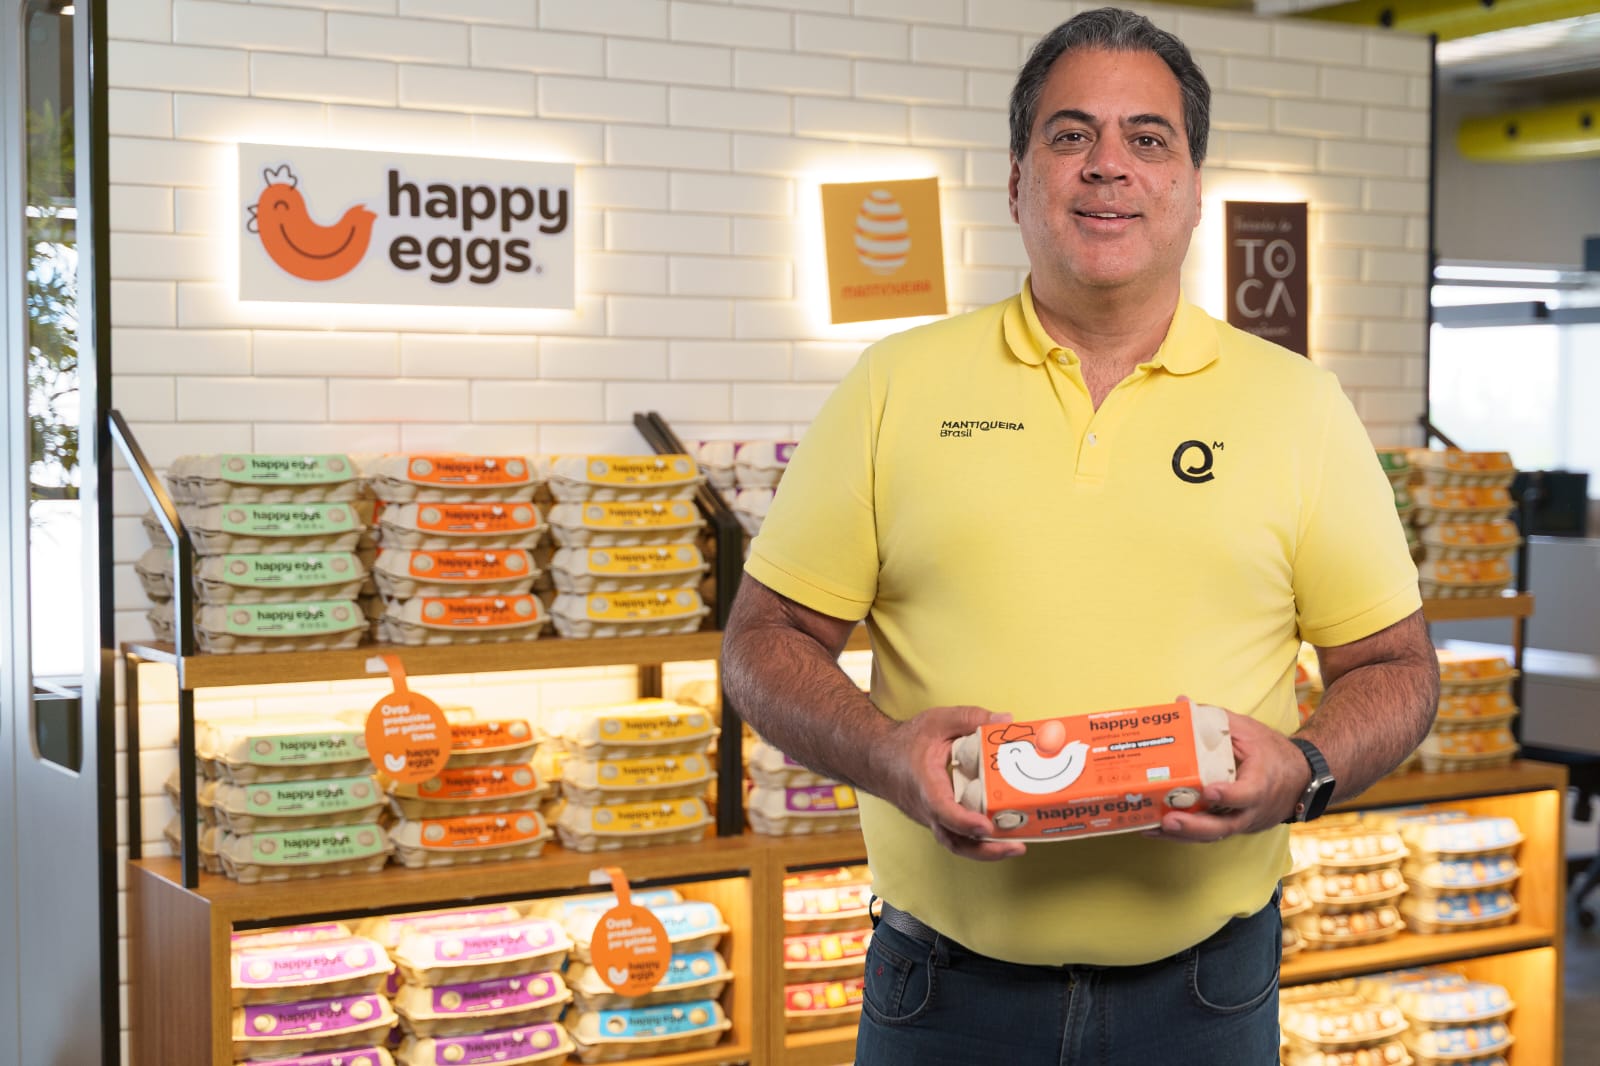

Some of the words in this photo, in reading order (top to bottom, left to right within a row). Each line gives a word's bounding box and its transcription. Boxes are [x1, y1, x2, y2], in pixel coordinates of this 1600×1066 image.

[388, 170, 568, 234] happy
[389, 236, 532, 284] eggs
[941, 420, 1025, 431] MANTIQUEIRA
[940, 429, 972, 437] Brasil
[252, 459, 289, 470] happy
[253, 510, 290, 521] happy
[255, 561, 292, 572] happy
[257, 610, 295, 621] happy
[1089, 718, 1139, 731] happy
[1142, 711, 1180, 725] eggs
[280, 739, 317, 750] happy
[277, 790, 314, 800] happy
[1036, 805, 1099, 820] happy
[283, 837, 321, 848] happy
